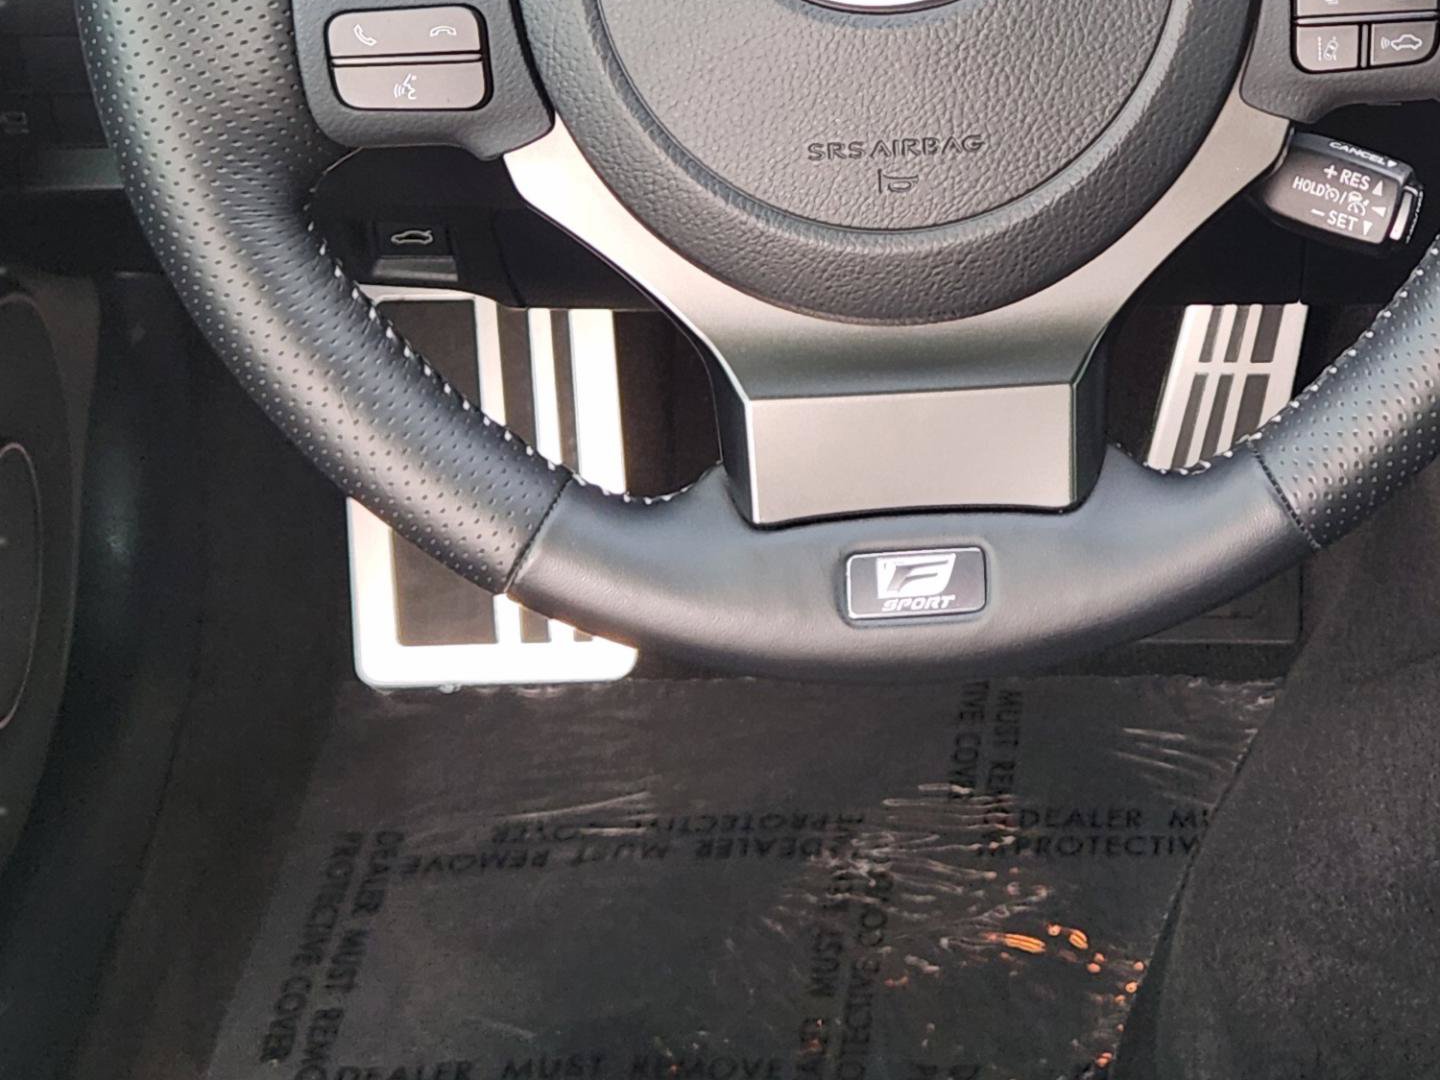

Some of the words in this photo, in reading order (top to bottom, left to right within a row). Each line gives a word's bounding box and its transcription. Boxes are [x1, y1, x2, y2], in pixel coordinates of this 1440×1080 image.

[808, 141, 866, 161] SRS
[869, 134, 985, 159] AIRBAG
[1329, 141, 1387, 166] CANCEL
[1292, 175, 1325, 199] HOLD
[1340, 169, 1371, 191] RES
[1327, 210, 1359, 231] SET
[881, 595, 956, 611] SPORT
[1019, 808, 1143, 829] DEALER
